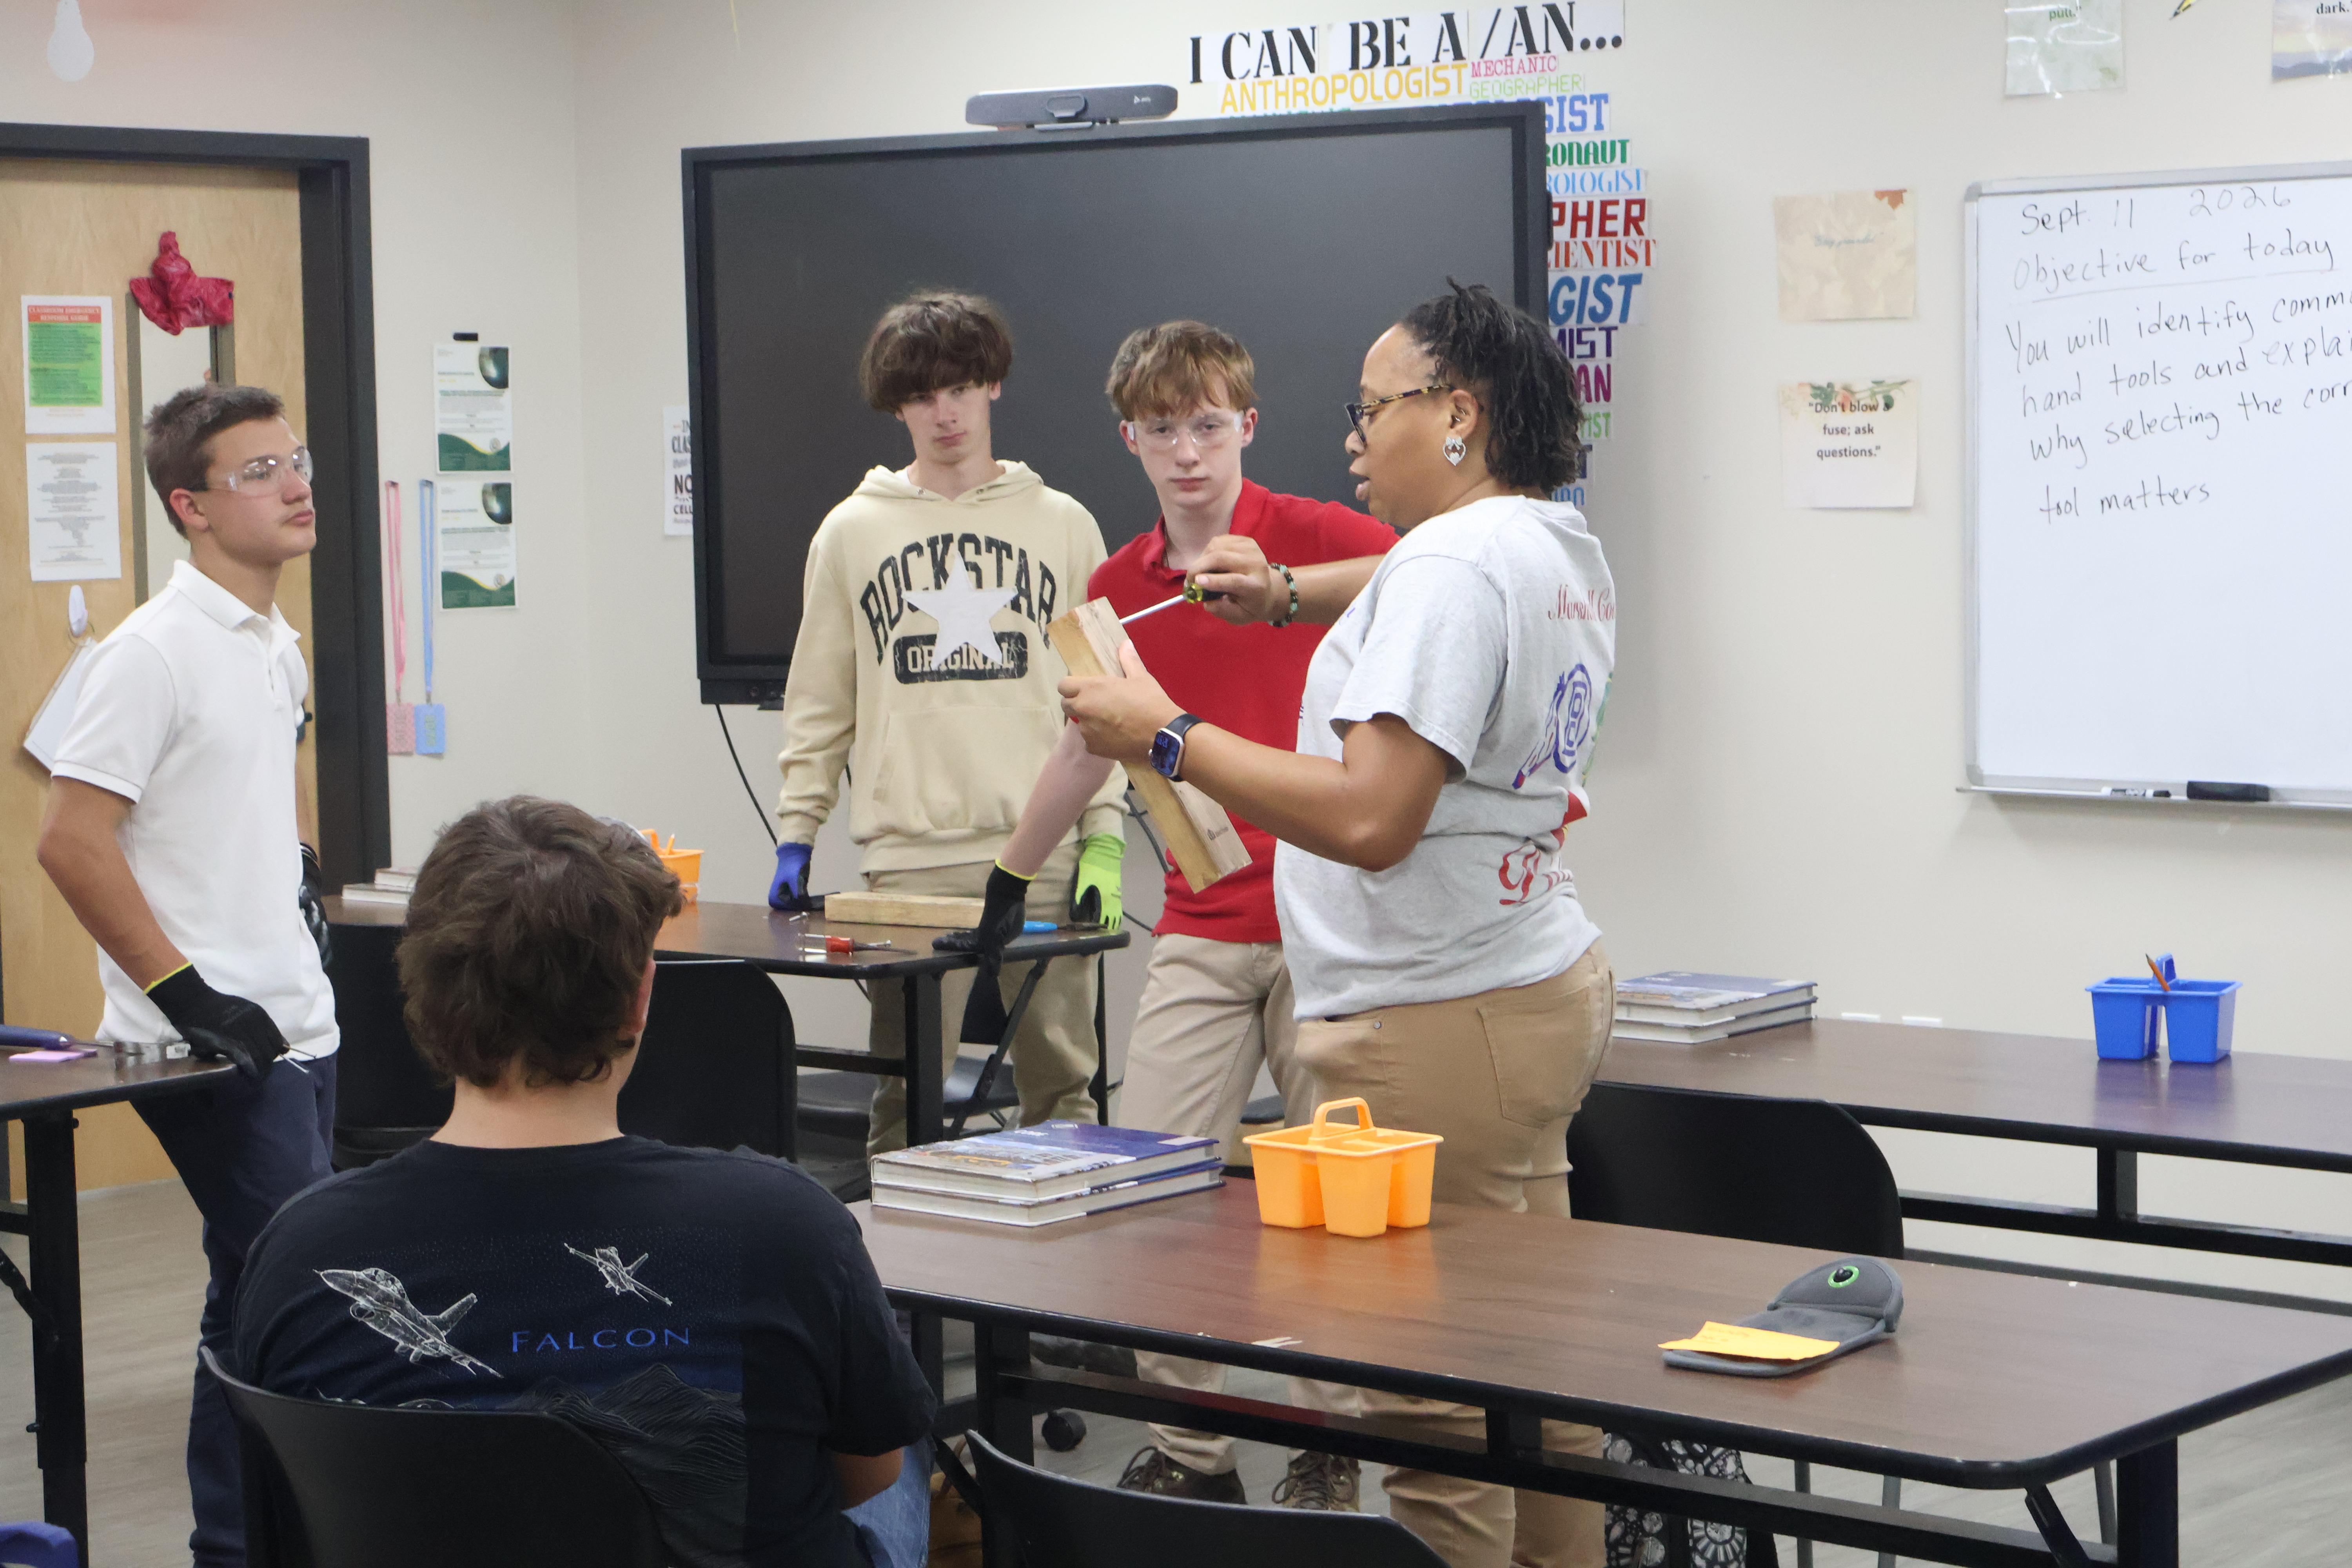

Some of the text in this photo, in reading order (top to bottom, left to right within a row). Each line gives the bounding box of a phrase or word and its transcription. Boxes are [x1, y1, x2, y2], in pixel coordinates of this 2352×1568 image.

[1190, 36, 1203, 83] I
[1221, 26, 1316, 80] CAN
[1349, 17, 1410, 71] BE
[1471, 55, 1558, 78] MECHANIC
[1221, 63, 1468, 114] ANTHROPOLOGIST
[1470, 74, 1583, 100] GEOGRAPHER
[2112, 198, 2133, 229] 11
[2190, 186, 2291, 216] 2026
[1548, 239, 1657, 268] IENTIST
[2014, 228, 2334, 294] Objective for today
[1549, 273, 1643, 325] GIST
[2006, 290, 2352, 373] You will identify comm
[1849, 400, 1879, 412] blow
[2022, 371, 2082, 417] hand
[2109, 361, 2172, 396] tools
[2194, 346, 2249, 379] and
[1855, 423, 1874, 434] ask
[2105, 402, 2220, 443] selecting
[2237, 391, 2282, 421] the
[2040, 475, 2210, 524] tool matters
[860, 533, 1056, 666] ROCKSTAR
[512, 1327, 689, 1353] FALCON
